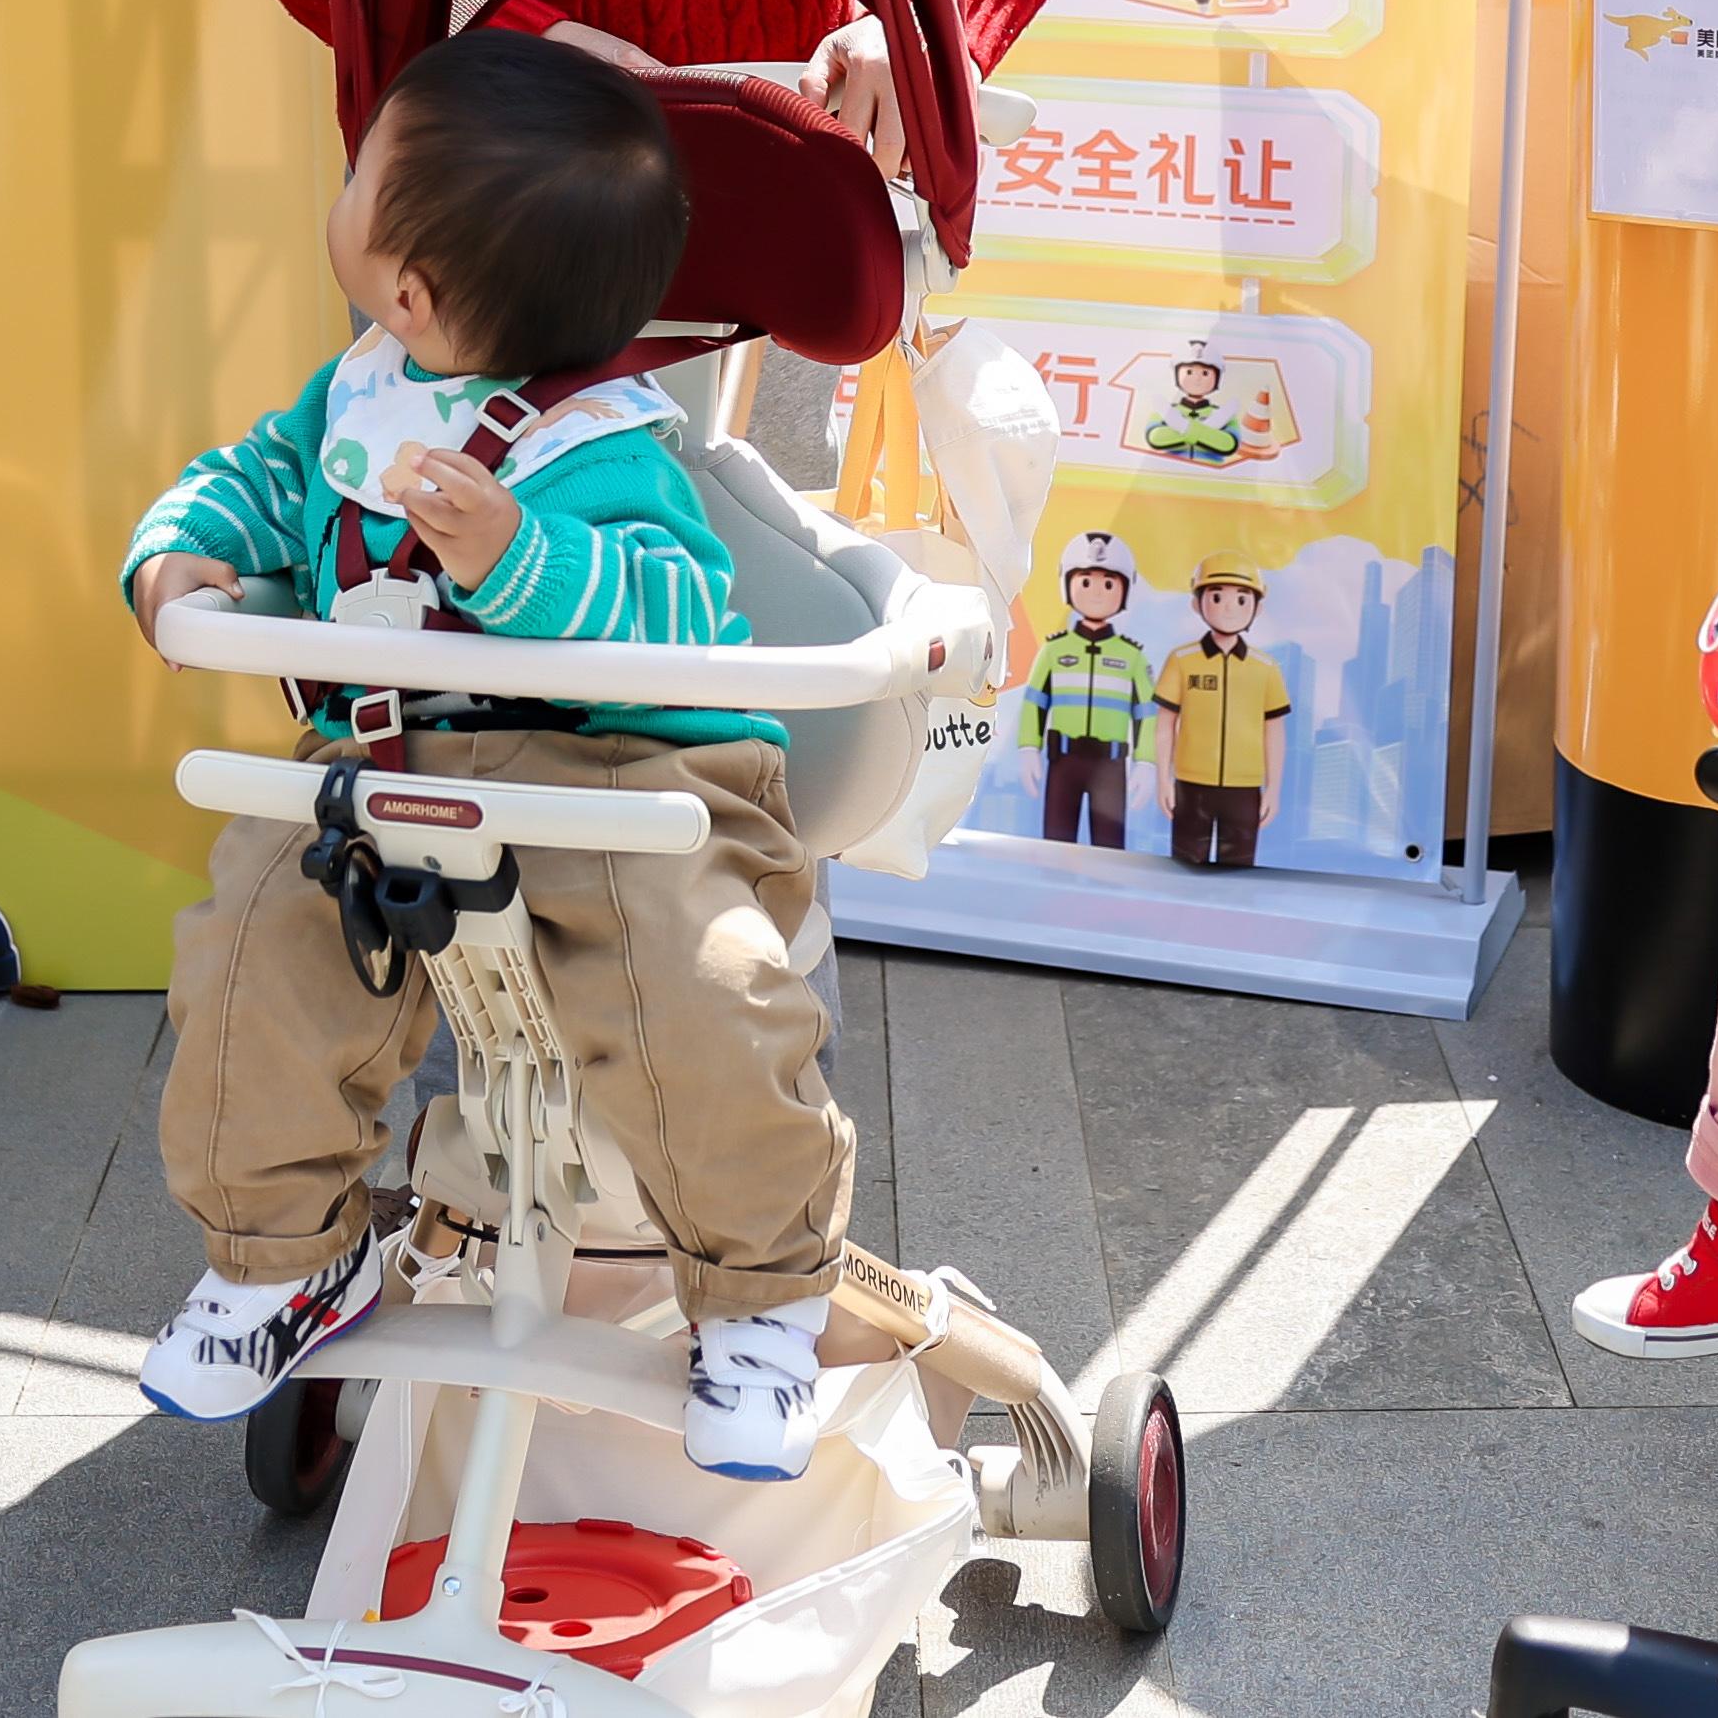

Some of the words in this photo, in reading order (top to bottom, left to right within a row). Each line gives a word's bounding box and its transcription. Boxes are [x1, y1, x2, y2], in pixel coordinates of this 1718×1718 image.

[995, 125, 1293, 212] 安全礼让
[924, 712, 996, 752] utte
[842, 1253, 926, 1317] MORHOME
